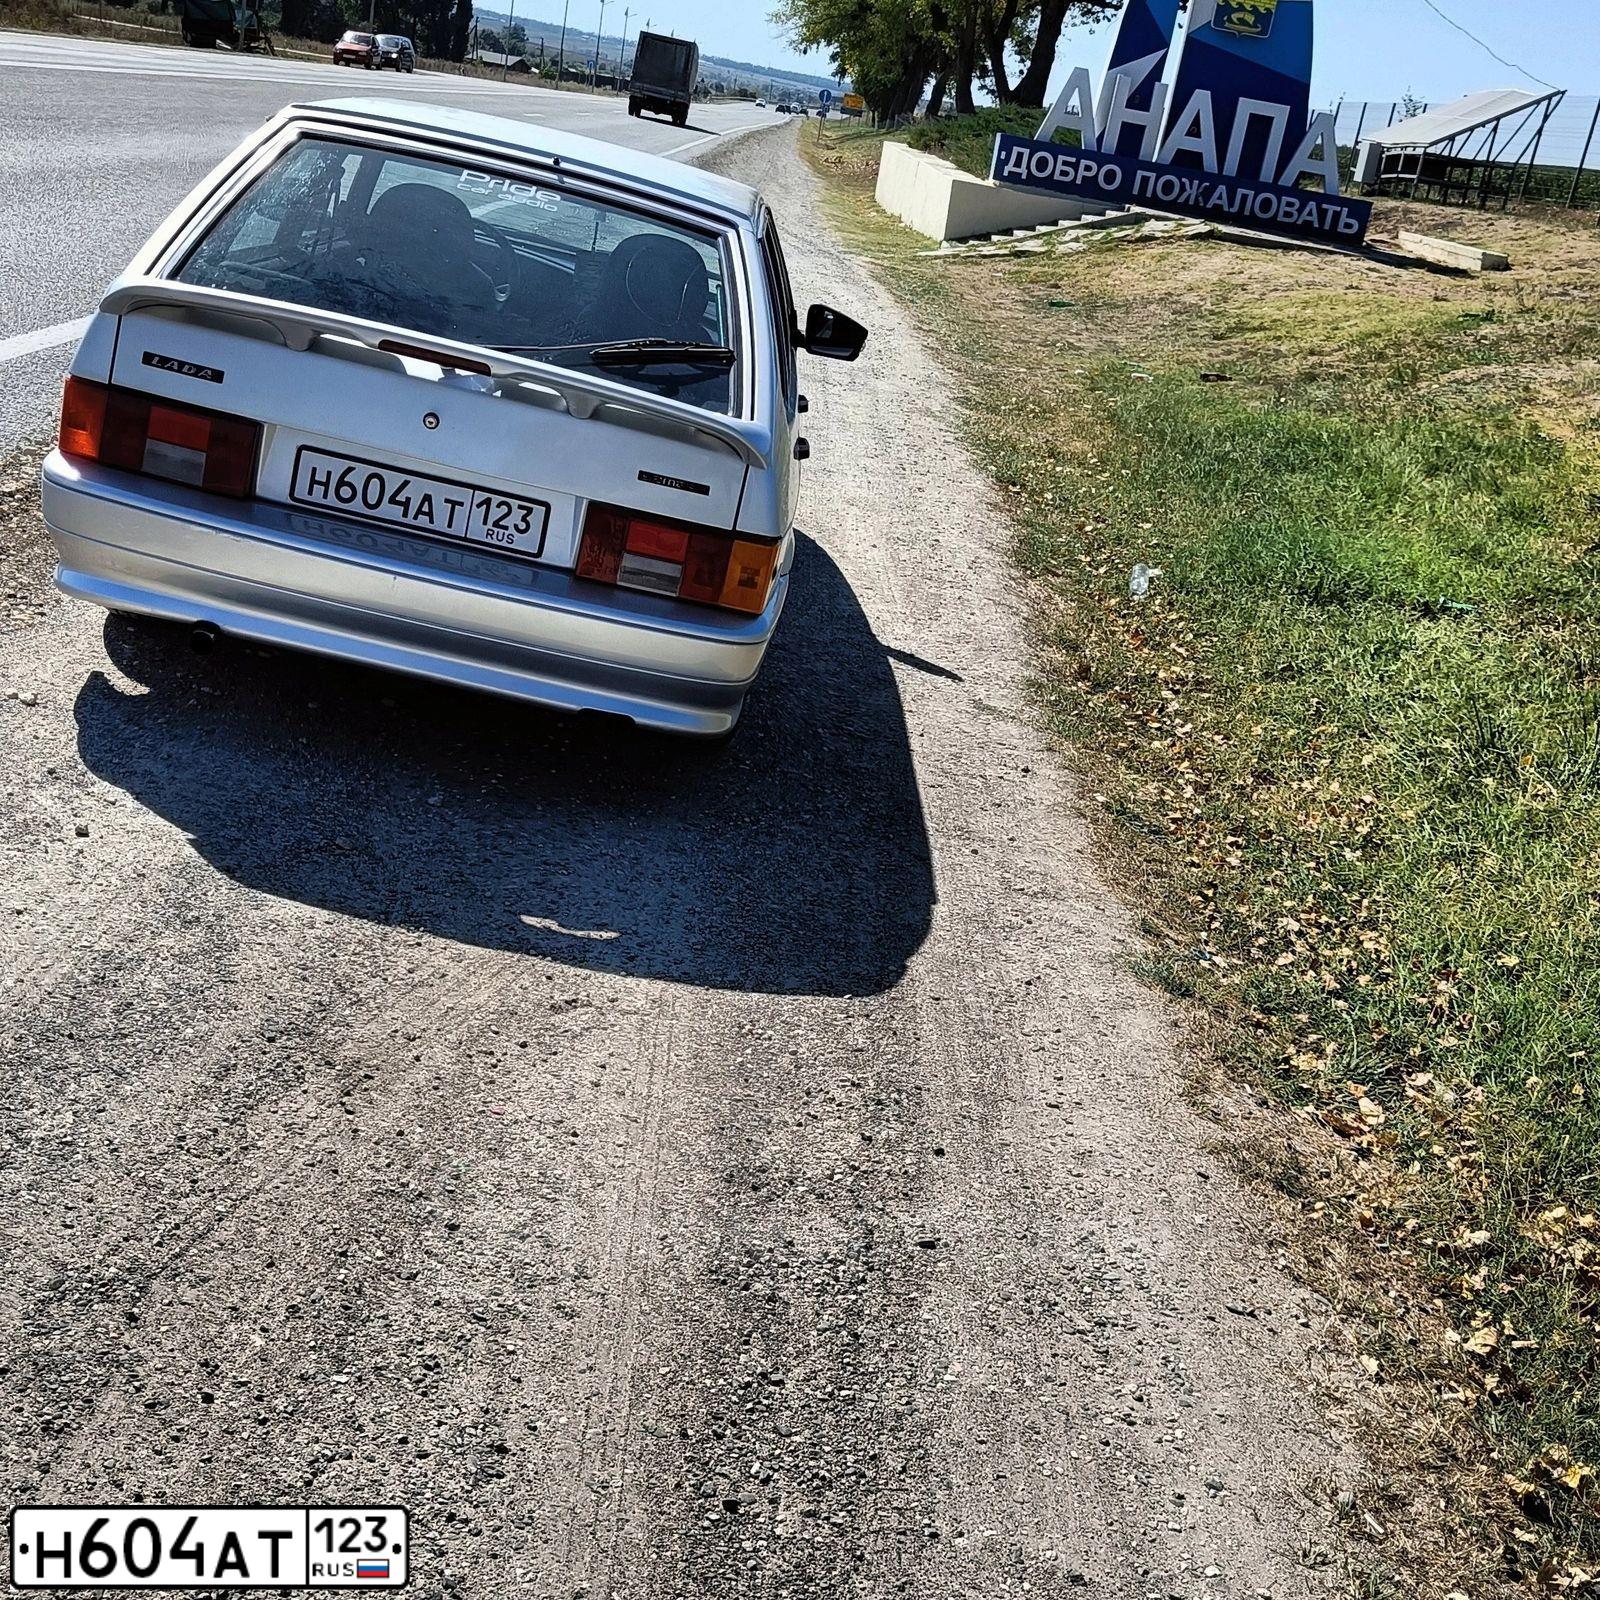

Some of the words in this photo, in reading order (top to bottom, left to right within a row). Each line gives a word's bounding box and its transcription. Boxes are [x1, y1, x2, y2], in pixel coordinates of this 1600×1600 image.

[1034, 66, 1339, 196] АНАПА
[456, 183, 493, 195] car
[498, 193, 558, 212] audio
[459, 169, 561, 202] Pride
[1003, 146, 1122, 190] ДОБРО
[1132, 170, 1359, 234] ПОЖАЛОВАТЬ
[151, 356, 212, 379] LADA
[475, 497, 534, 534] 123
[485, 528, 515, 545] RUS
